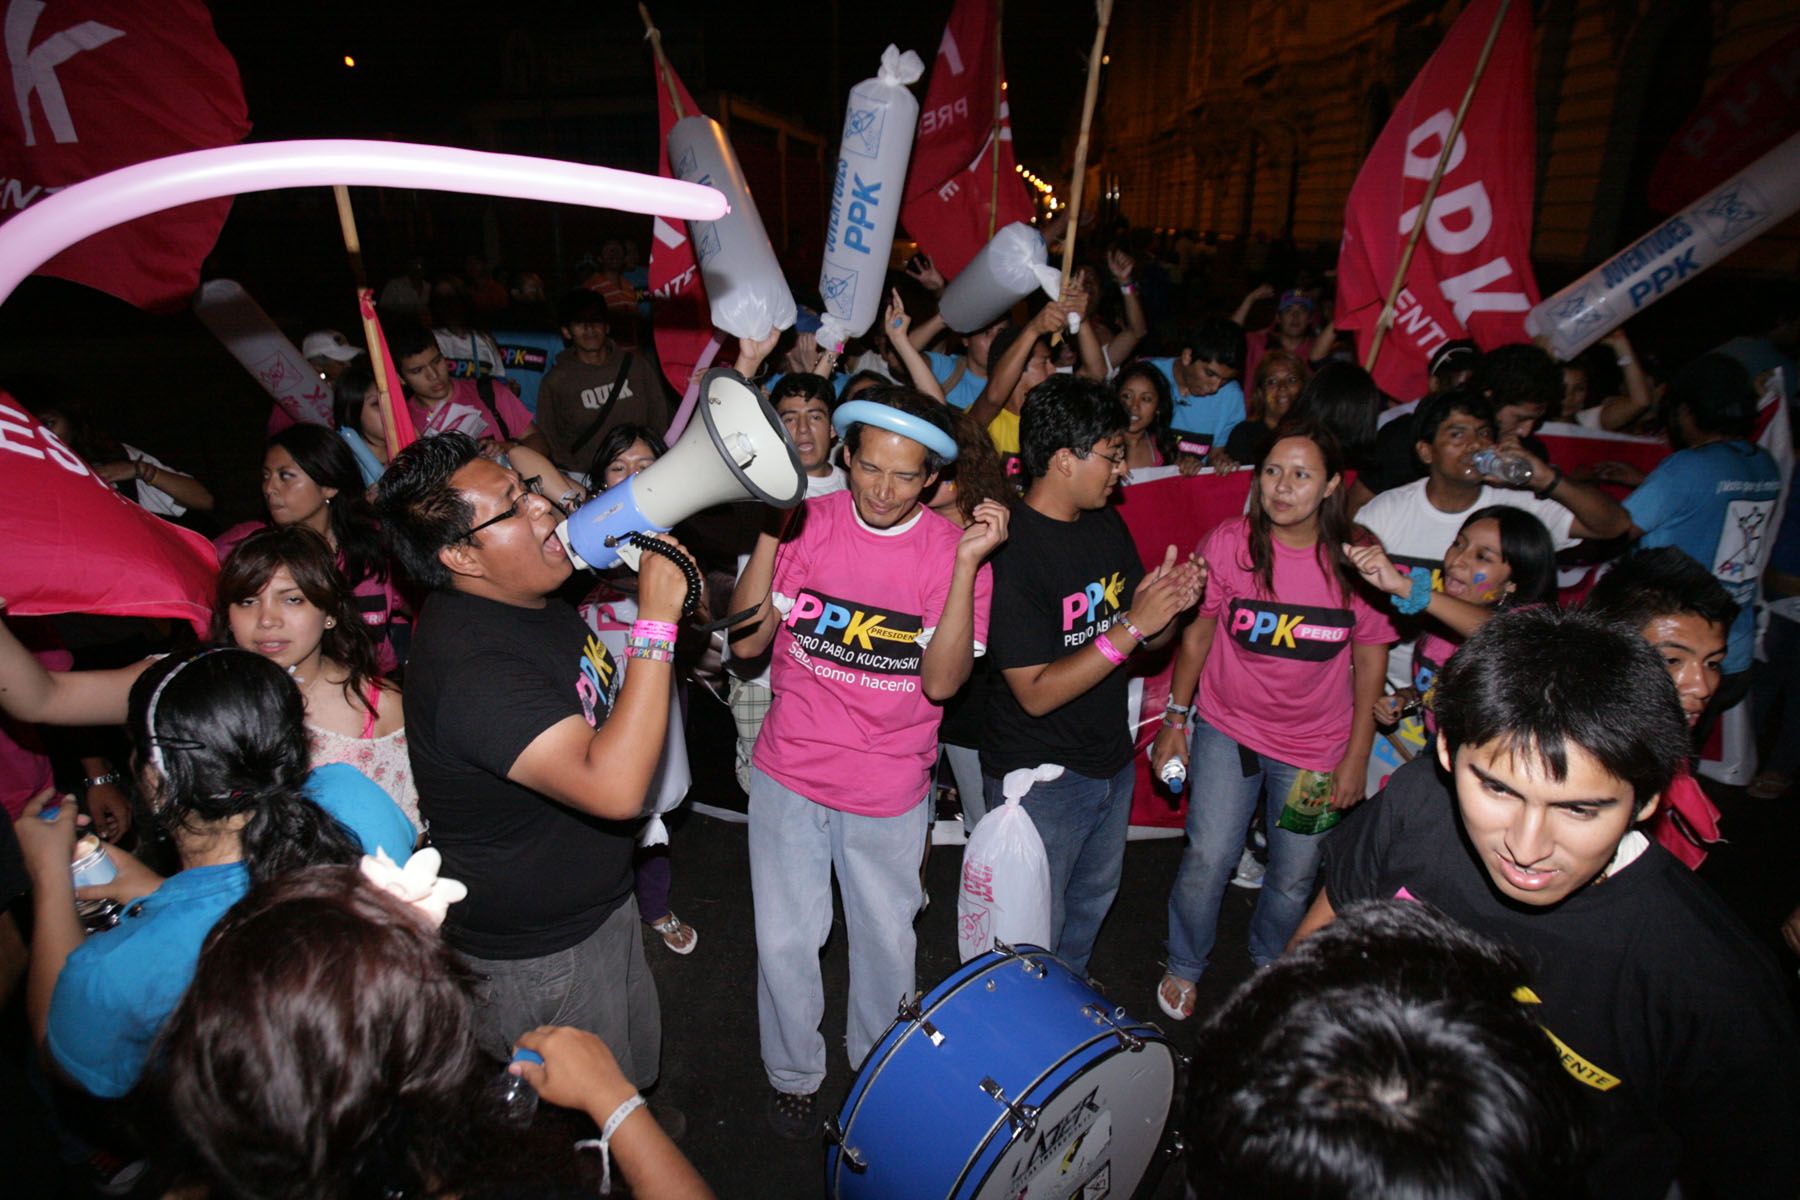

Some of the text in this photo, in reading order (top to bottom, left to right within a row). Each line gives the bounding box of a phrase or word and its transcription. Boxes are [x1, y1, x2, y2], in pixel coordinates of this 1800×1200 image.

[843, 172, 882, 255] PPK
[1628, 245, 1701, 308] PPK
[786, 592, 918, 651] PPK PRESIDEN
[1062, 571, 1120, 632] PPK
[1231, 607, 1345, 649] PPK PERÚ
[575, 633, 614, 728] PPK
[814, 665, 856, 684] como
[860, 673, 916, 693] hacerlo
[819, 640, 855, 663] PABLO
[855, 653, 920, 670] KUCZYNSKI
